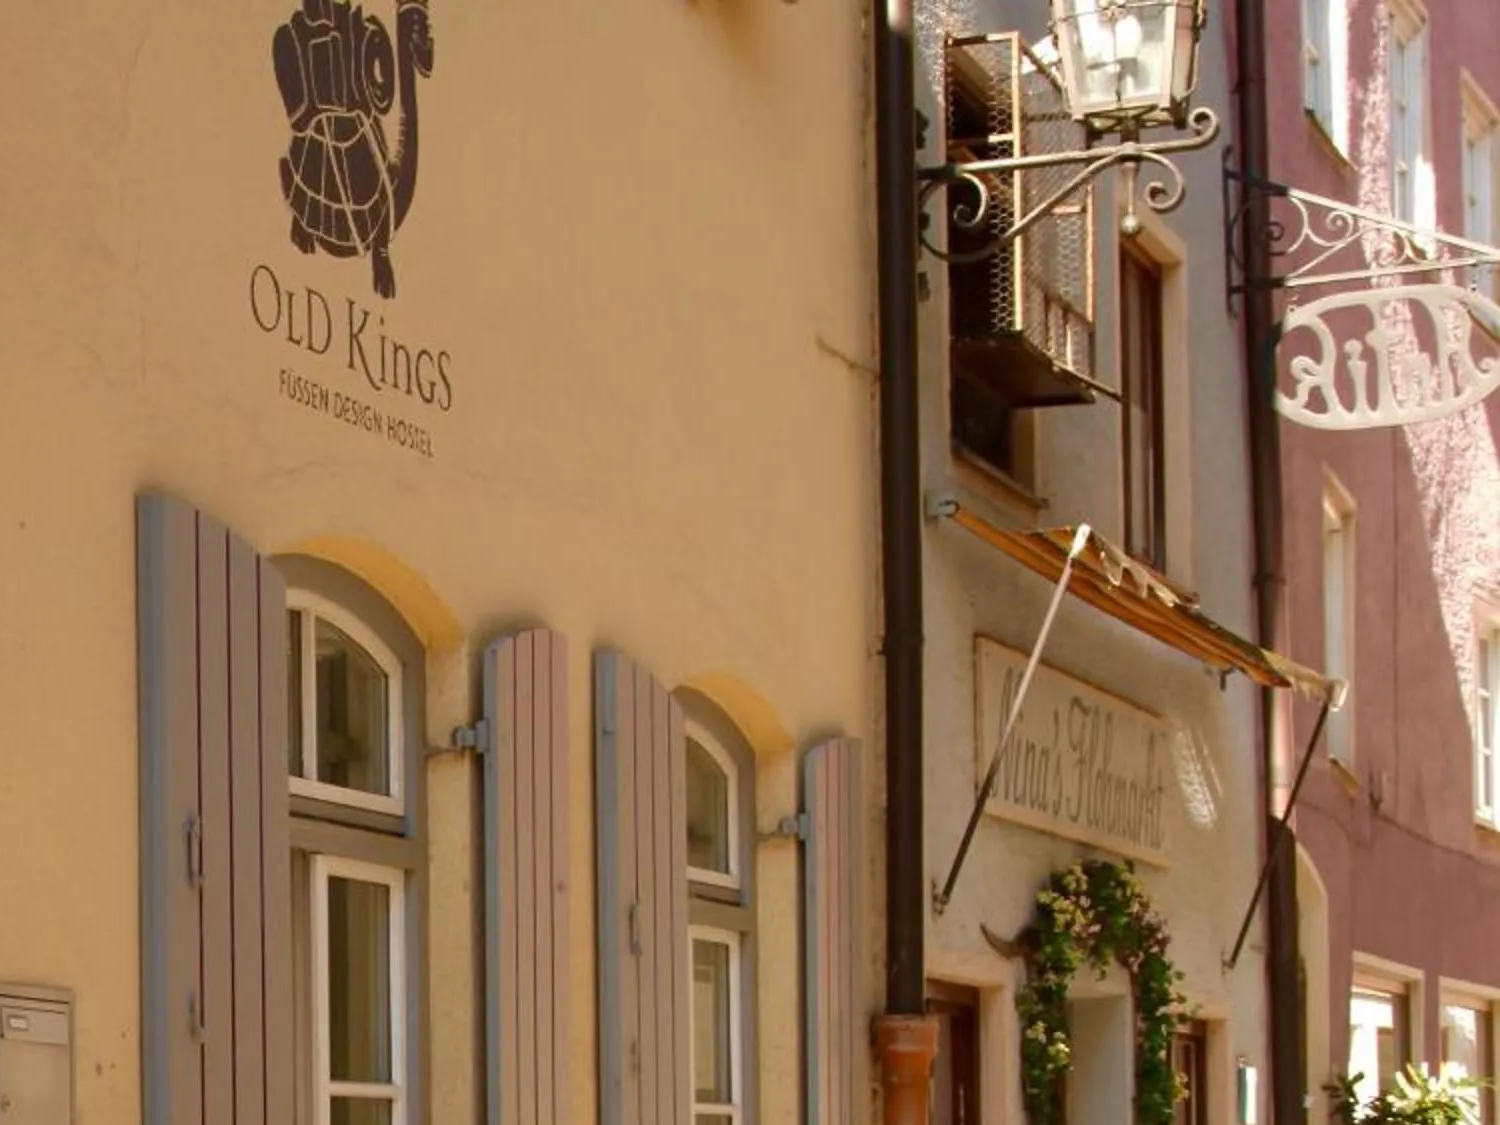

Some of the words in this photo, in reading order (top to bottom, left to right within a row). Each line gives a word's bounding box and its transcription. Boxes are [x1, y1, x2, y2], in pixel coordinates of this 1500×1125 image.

[251, 265, 332, 354] OLD
[332, 391, 383, 433] DESIGN
[386, 414, 435, 458] HOSTEL
